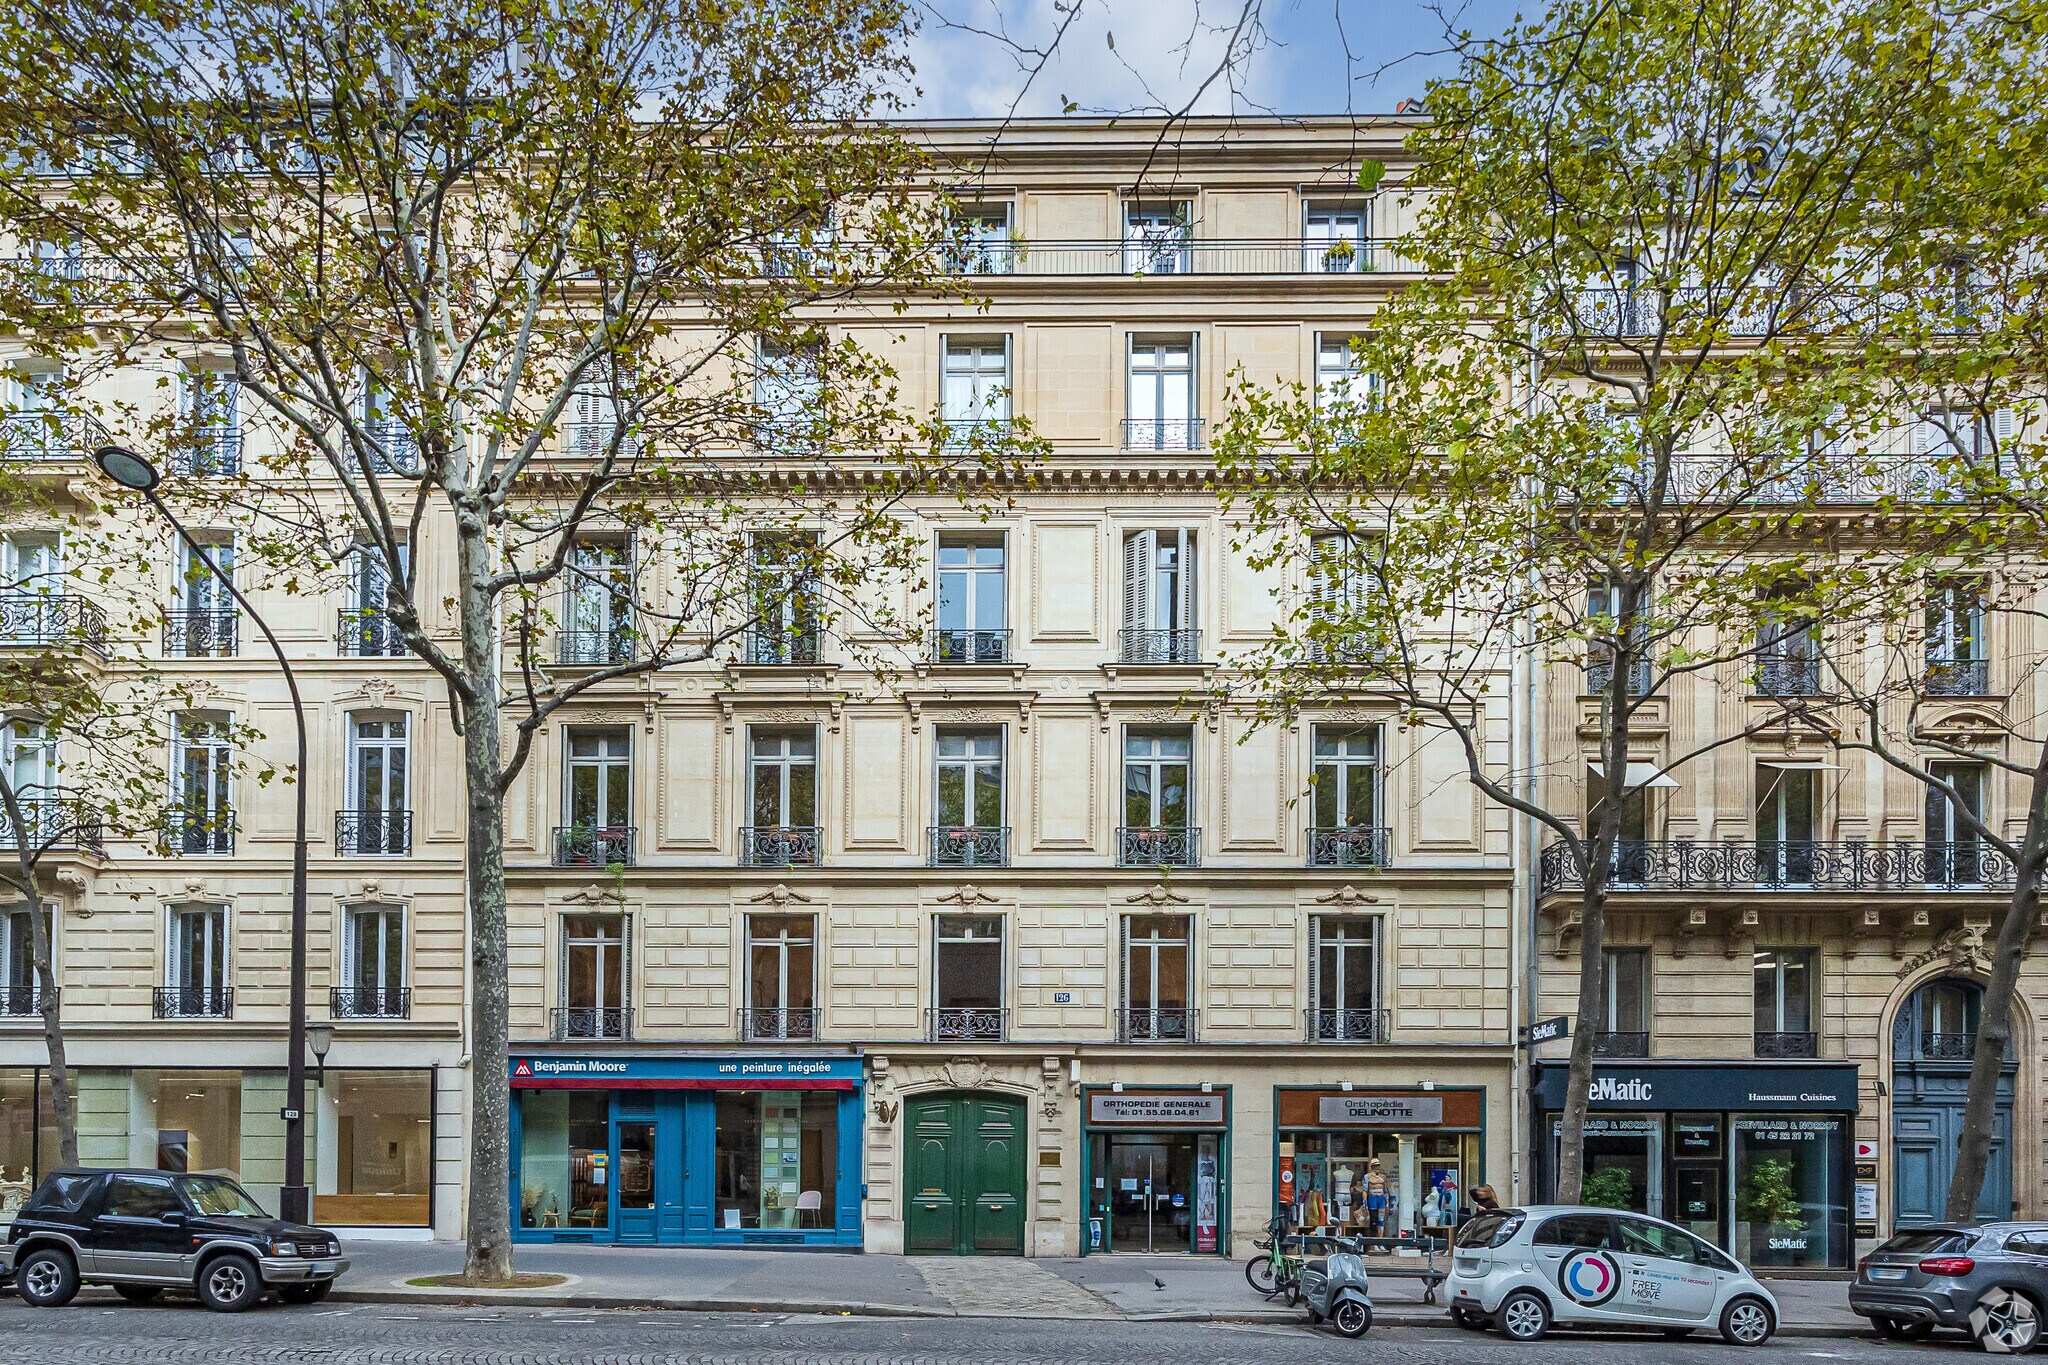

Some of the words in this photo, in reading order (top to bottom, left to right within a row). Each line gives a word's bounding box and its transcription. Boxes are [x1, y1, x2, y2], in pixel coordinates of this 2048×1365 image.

[1056, 993, 1069, 1002] 126
[1532, 1022, 1558, 1041] SieMatic
[534, 1060, 587, 1075] Benjamin
[588, 1060, 628, 1072] Moore
[719, 1063, 737, 1072] une
[742, 1062, 783, 1075] peinture
[788, 1061, 832, 1075] inégalée
[1588, 1078, 1652, 1100] eMatic
[1748, 1093, 1797, 1101] Haussmann
[1800, 1093, 1837, 1102] Cuisines
[1103, 1100, 1160, 1108] ORTHOPEDIE
[1345, 1100, 1404, 1109] Orthopédie
[1349, 1108, 1413, 1117] DELINOTTE
[1790, 1121, 1798, 1130] &
[1755, 1131, 1765, 1140] 01
[1779, 1131, 1790, 1140] 22
[1768, 1237, 1808, 1249] SieMatic
[1632, 1280, 1661, 1291] FREE2
[1631, 1288, 1661, 1300] MOVE
